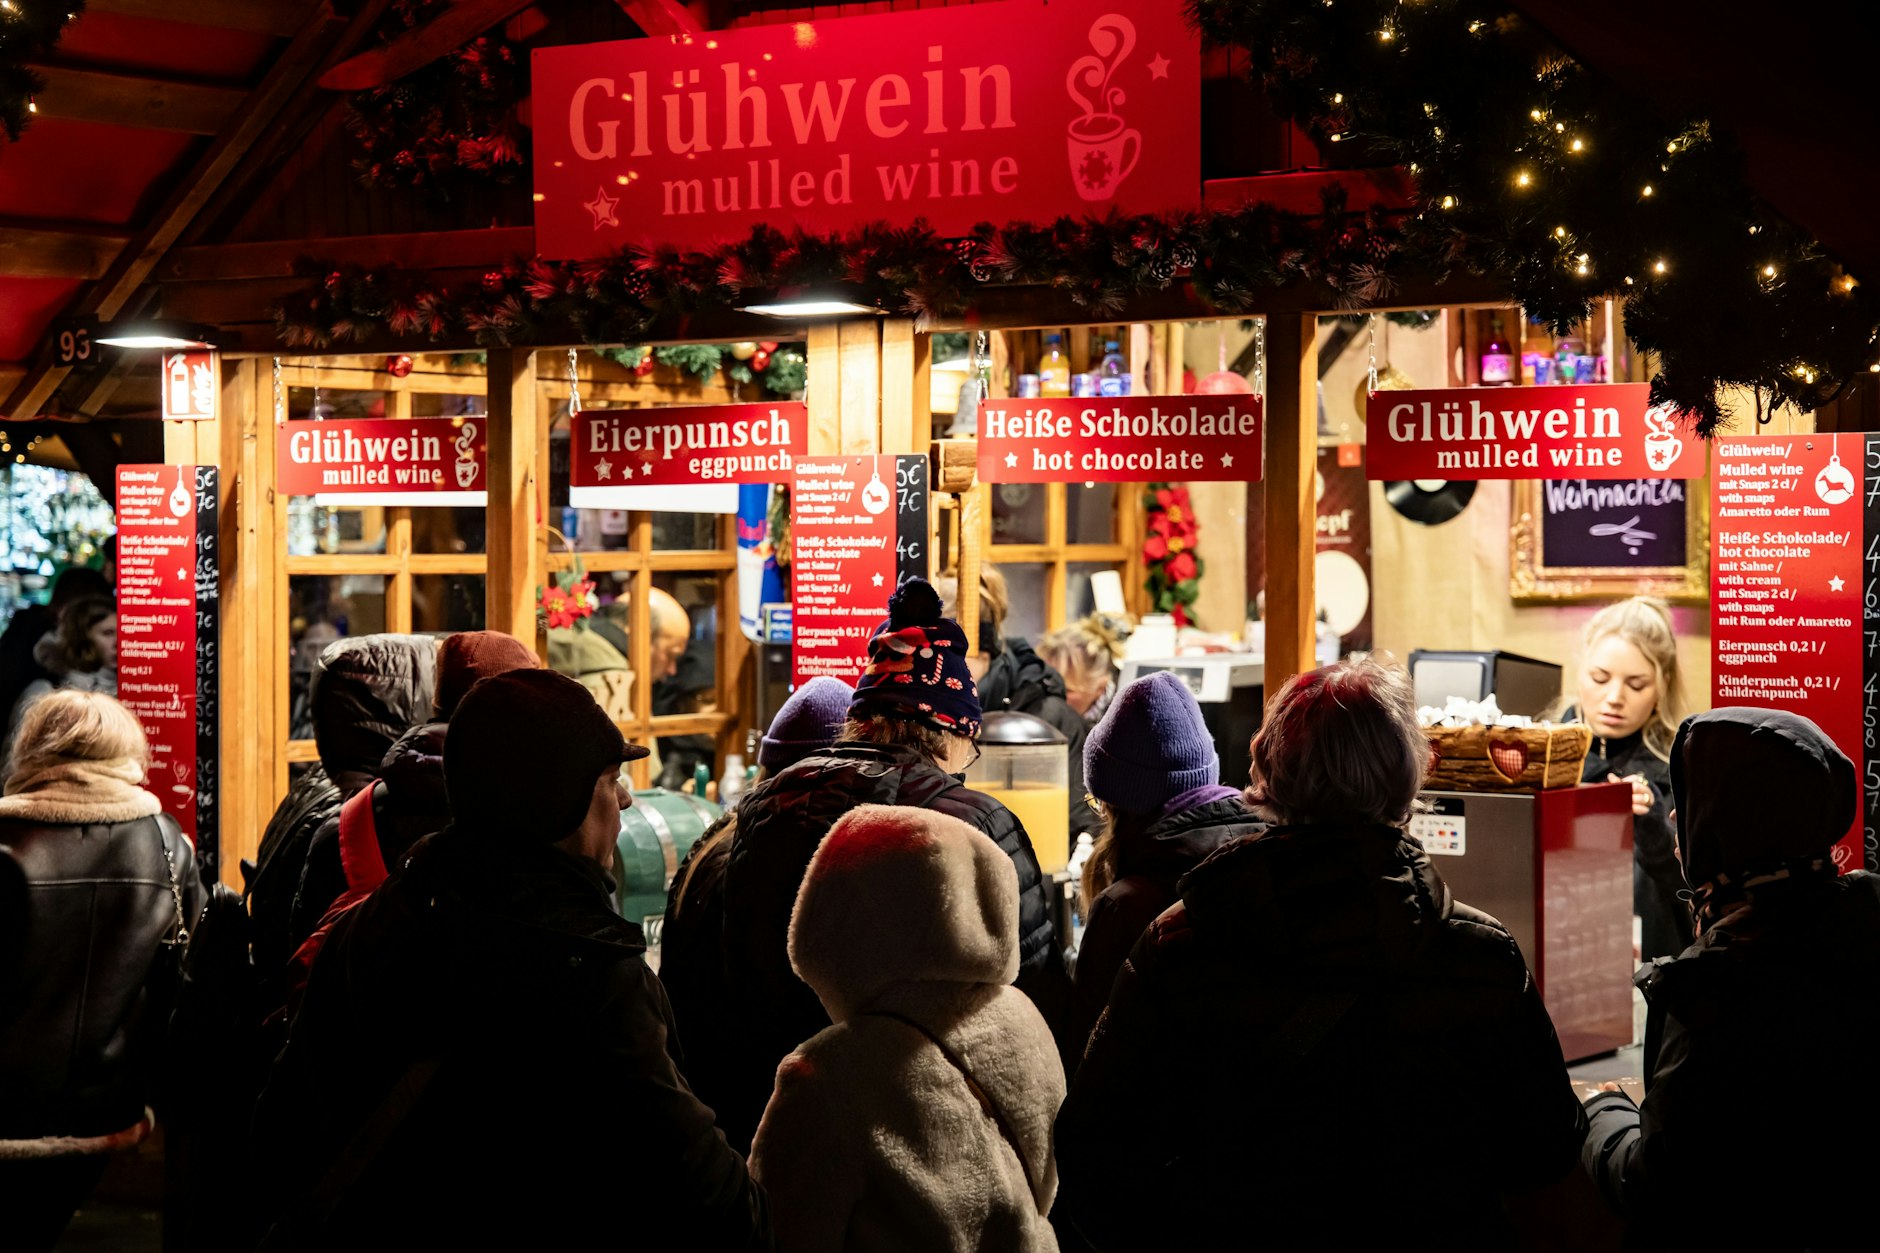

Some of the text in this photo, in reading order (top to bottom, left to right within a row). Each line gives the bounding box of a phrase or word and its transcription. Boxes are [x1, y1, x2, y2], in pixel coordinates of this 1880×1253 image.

[569, 45, 1016, 161] Glühwein
[662, 148, 1019, 216] mulled wine
[985, 407, 1255, 439] Heiße Schokolade
[1388, 398, 1622, 442] Glühwein
[590, 410, 791, 459] Eierpunsch
[290, 429, 440, 463] Glühwein
[1719, 443, 1792, 459] Glühwein/
[1033, 448, 1204, 470] hot chocolate
[1437, 443, 1622, 469] mulled wine
[689, 450, 792, 479] eggpunch
[1720, 463, 1803, 476] Mulled wine
[323, 464, 442, 485] mulled wine
[896, 458, 920, 486] 5€
[796, 480, 855, 490] Mulled wine
[1719, 480, 1738, 489] mit
[1739, 479, 1770, 491] Snaps
[1771, 479, 1778, 489] 2
[796, 493, 809, 502] mit
[896, 488, 920, 514] 7€
[1719, 493, 1775, 505] with snaps
[796, 504, 813, 513] with
[1719, 507, 1829, 517] Amaretto oder Rum
[796, 515, 873, 524] Amaretto oder Rum
[797, 537, 825, 547] Heiße
[1719, 531, 1850, 547] Heiße Schokolade/
[121, 546, 169, 555] hot chocolate
[797, 548, 860, 558] hot chocolate
[896, 536, 920, 561] 4€
[1719, 546, 1810, 557] hot chocolate
[797, 561, 836, 570] mit Sahne
[1719, 561, 1738, 571] mit
[1740, 561, 1774, 571] Sahne
[797, 572, 840, 581] with cream
[1719, 575, 1781, 584] with cream
[797, 584, 810, 592] mit
[811, 584, 832, 595] Snaps
[1719, 589, 1737, 598] mit
[1738, 589, 1769, 600] Snaps
[1771, 589, 1778, 598] 2
[1866, 577, 1877, 608] 6
[797, 595, 836, 606] with snaps
[797, 607, 811, 615] mit
[812, 607, 830, 615] Rum
[831, 607, 850, 615] oder
[1719, 602, 1774, 614] with snaps
[1719, 616, 1851, 627] mit Rum oder Amaretto
[798, 626, 859, 638] Eierpunsch 0,2
[121, 640, 164, 651] Kinderpunch
[798, 637, 838, 648] eggpunch
[1719, 640, 1787, 653] Eierpunsch
[1790, 641, 1808, 652] 0,2
[121, 649, 168, 659] childrenpunch
[1719, 652, 1777, 665] eggpunch
[798, 656, 853, 668] Kinderpunch
[121, 665, 137, 676] Grog
[798, 667, 859, 677] childrenpunch
[1719, 675, 1798, 687] Kinderpunch
[1804, 677, 1822, 689] 0,2
[1719, 687, 1807, 700] childrenpunch
